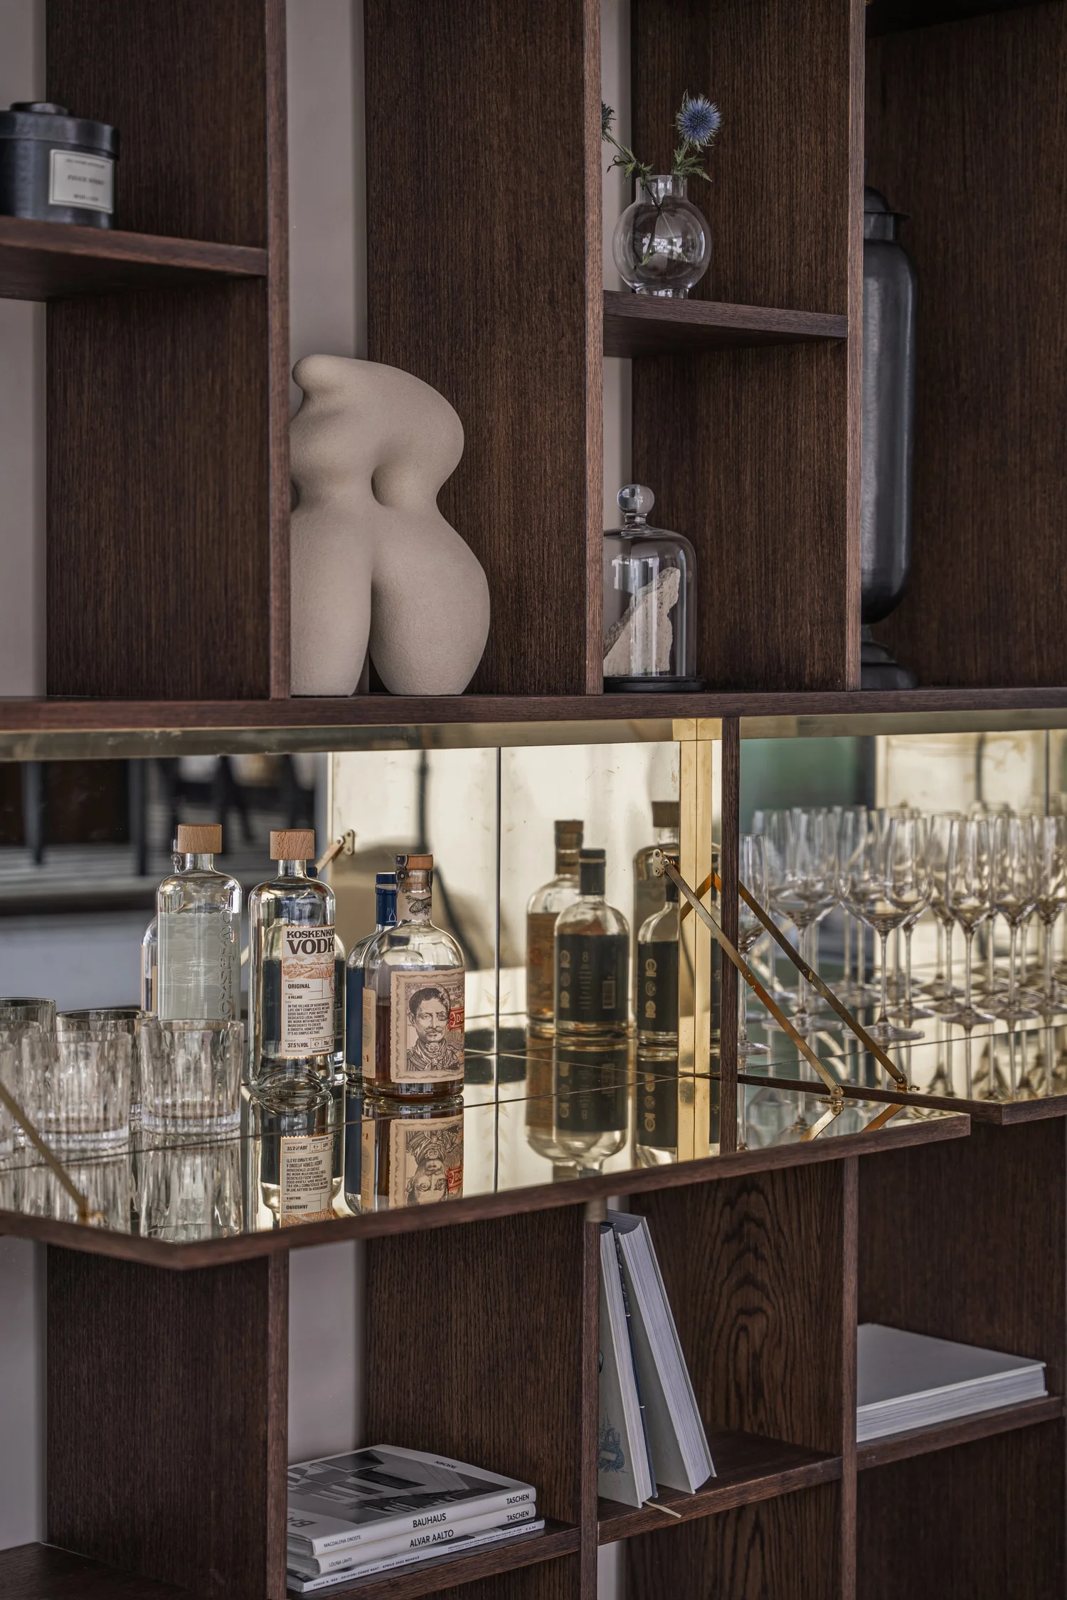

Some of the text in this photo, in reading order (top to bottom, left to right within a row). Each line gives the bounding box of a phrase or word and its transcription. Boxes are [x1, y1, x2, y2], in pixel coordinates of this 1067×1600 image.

[506, 1493, 530, 1505] TASCHEN
[412, 1512, 447, 1528] BAUHAUS
[506, 1510, 530, 1522] TASCHEN
[409, 1535, 431, 1548] ALVAR
[431, 1529, 455, 1542] AALTO
